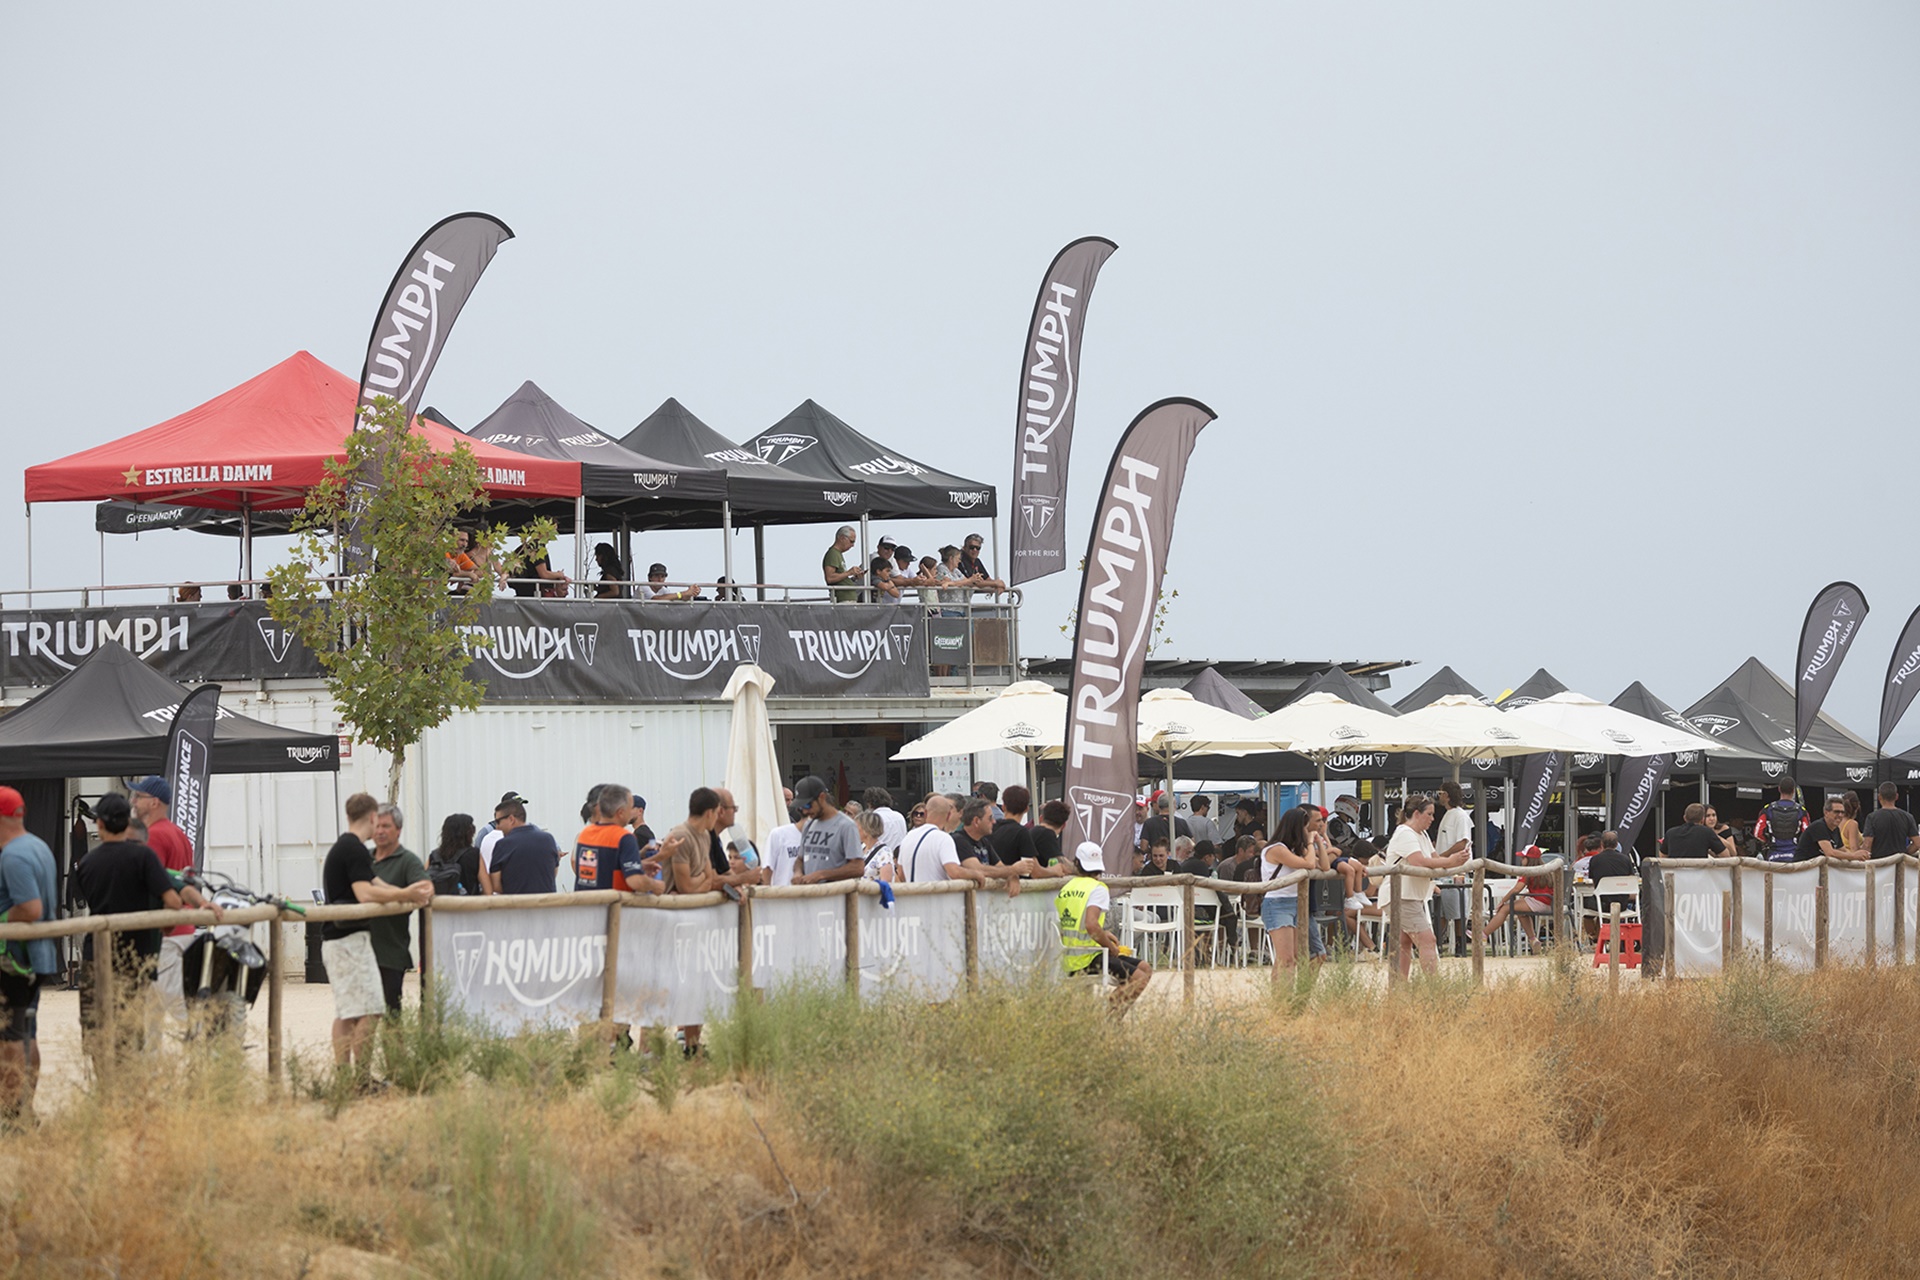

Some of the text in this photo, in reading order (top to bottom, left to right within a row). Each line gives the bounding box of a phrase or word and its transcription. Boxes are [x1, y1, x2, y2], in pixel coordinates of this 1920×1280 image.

[354, 250, 455, 453] RIUMPH
[1021, 282, 1077, 481] TRIUMPH
[145, 464, 273, 486] ESTRELLA DAMM
[495, 468, 526, 487] DAMM
[633, 473, 669, 490] TRIUMPH
[823, 490, 851, 506] TRIUMPH
[949, 490, 983, 509] TRIUMPH
[1072, 455, 1159, 769] TRIUMPH
[2, 616, 189, 671] TRIUMPH
[628, 629, 740, 680] TRIUMPH
[788, 630, 892, 679] TRIUMPH
[1802, 619, 1842, 682] TRIUMPH
[287, 746, 322, 764] TRIUMPH
[1761, 761, 1784, 778] TRIUMPH
[1845, 767, 1869, 783] TRIUMPH
[177, 739, 192, 834] FORMANCE
[1083, 792, 1115, 806] TRIUMPH
[1521, 766, 1553, 830] TRIUMPH
[1619, 767, 1657, 831] TRIUMPH
